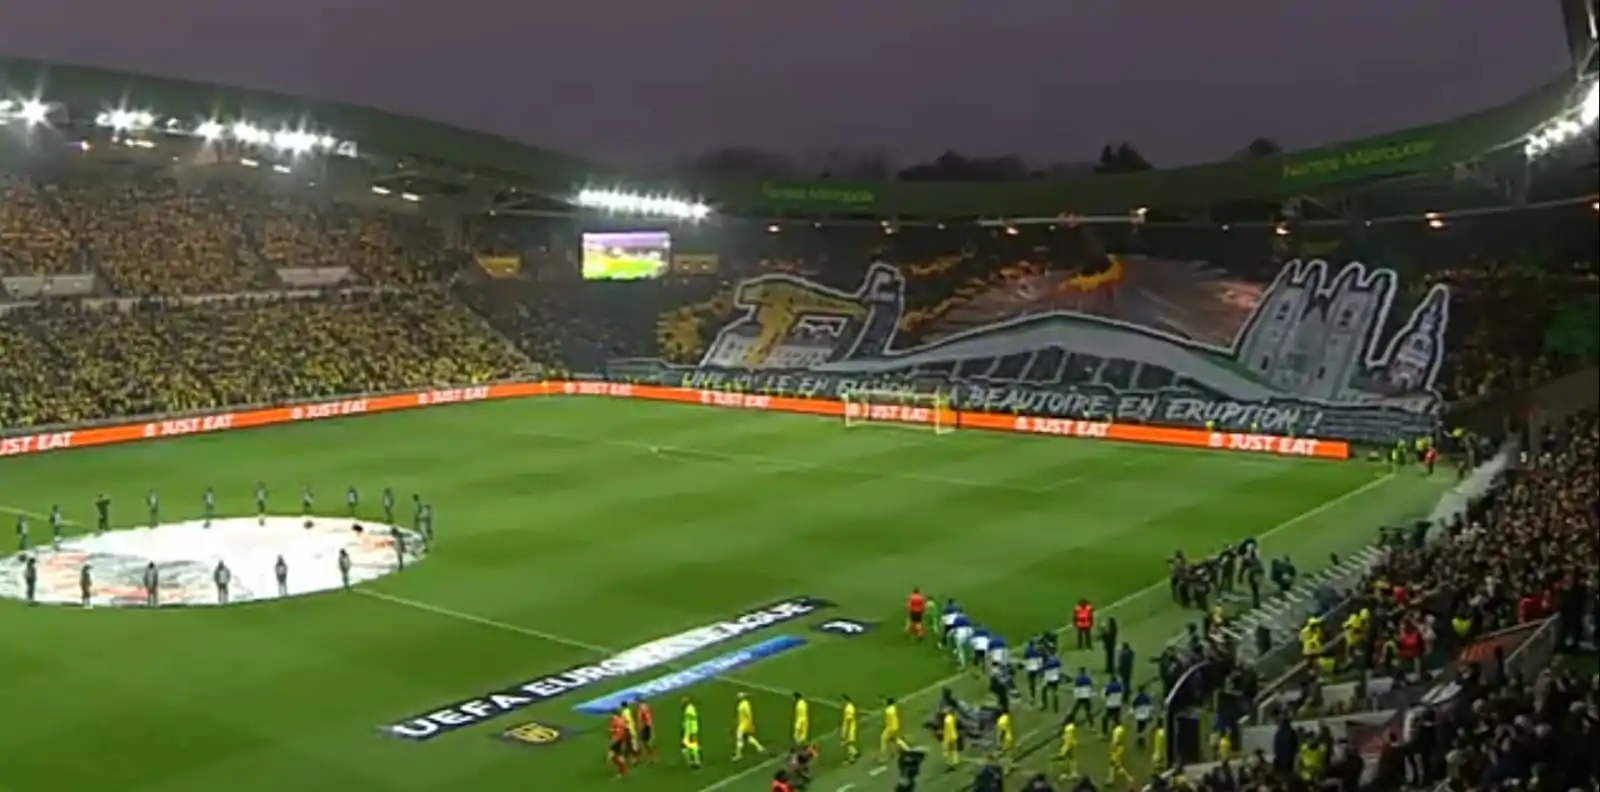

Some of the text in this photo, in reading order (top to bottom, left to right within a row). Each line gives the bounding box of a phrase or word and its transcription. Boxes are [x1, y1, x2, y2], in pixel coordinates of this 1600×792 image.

[306, 400, 367, 418] JUST EAT
[1117, 395, 1159, 418] EN
[1165, 398, 1302, 432] ERUPTION
[160, 414, 234, 436] JUST EAT
[1031, 416, 1111, 438] JUST EAT
[37, 432, 75, 450] EAT
[1228, 432, 1319, 456] JUST EAT
[392, 694, 533, 738] UEFA
